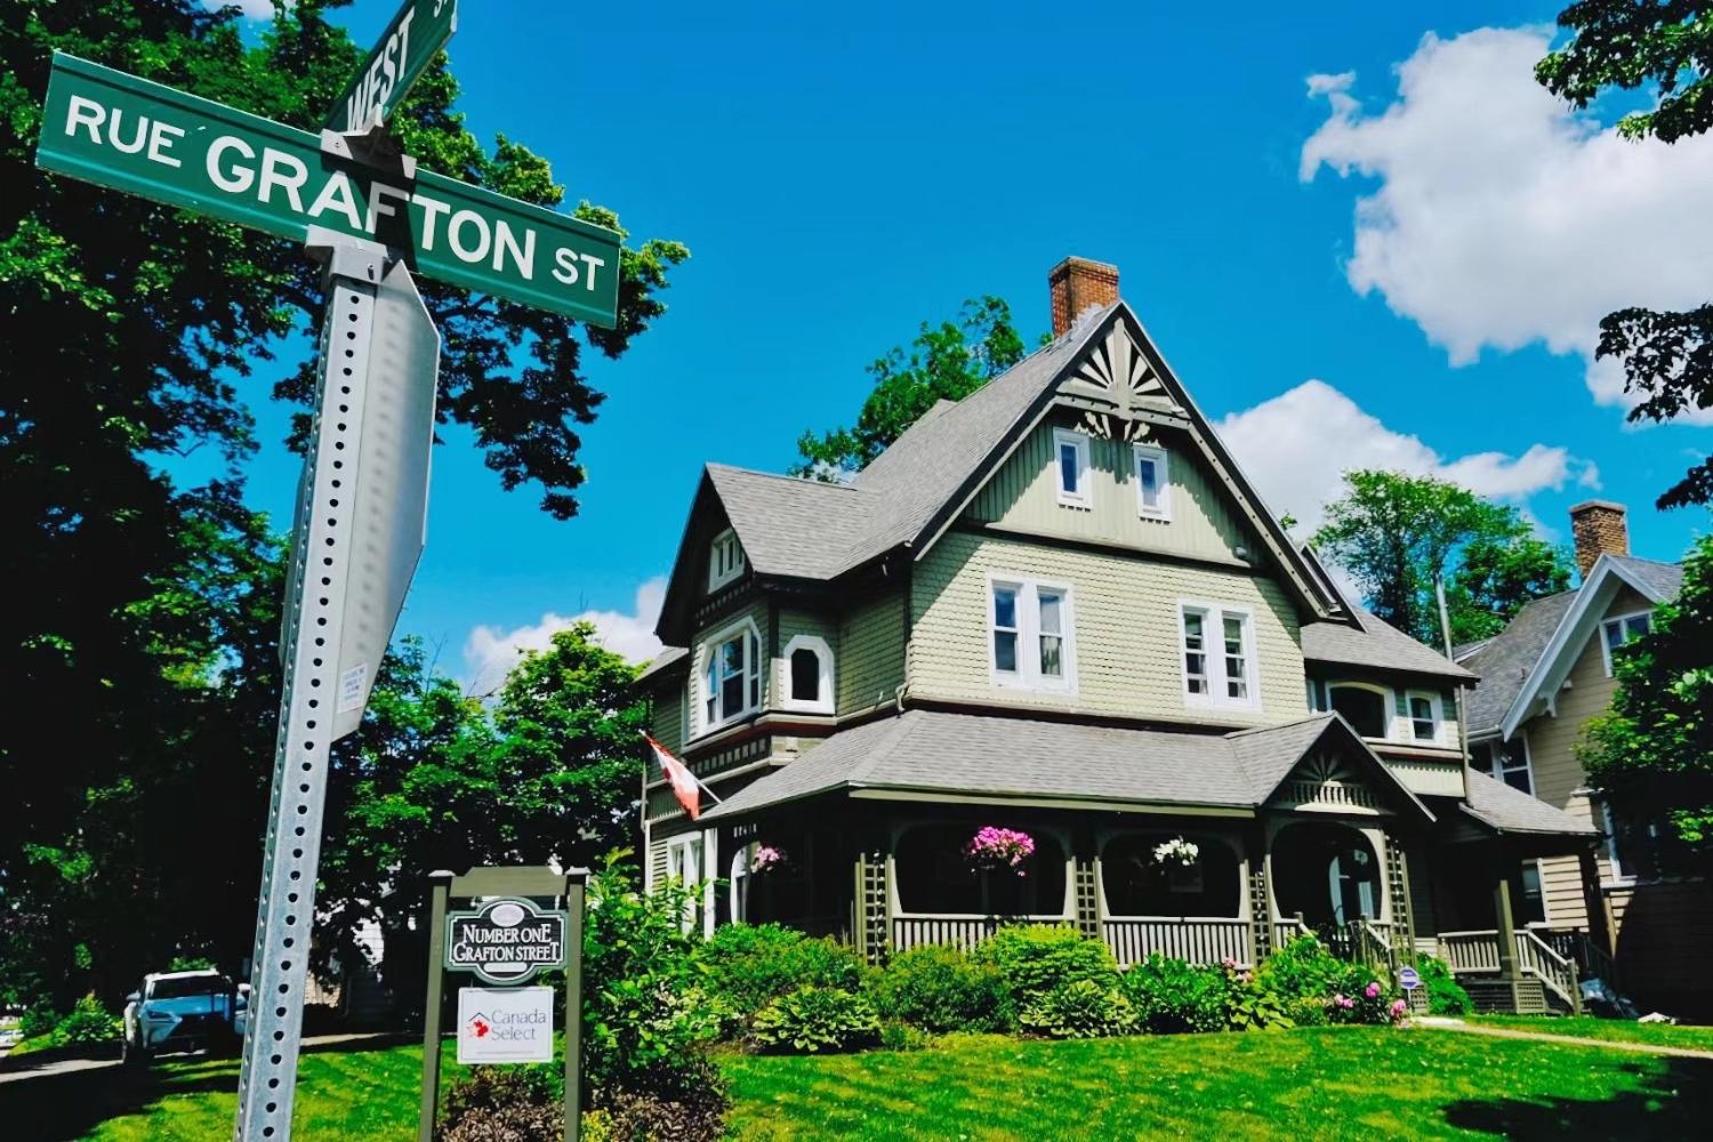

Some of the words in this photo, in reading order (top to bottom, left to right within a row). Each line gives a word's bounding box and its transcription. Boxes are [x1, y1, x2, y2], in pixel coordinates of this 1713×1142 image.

[347, 6, 415, 132] WEST
[65, 94, 186, 168] RUE
[206, 135, 537, 281] GRAFTON
[552, 247, 605, 291] ST
[462, 923, 520, 944] NUMBER
[521, 923, 552, 943] ONE
[453, 941, 515, 962] GRAFTON
[515, 941, 560, 962] STREET
[491, 1008, 546, 1025] Canada
[491, 1026, 537, 1042] Select
